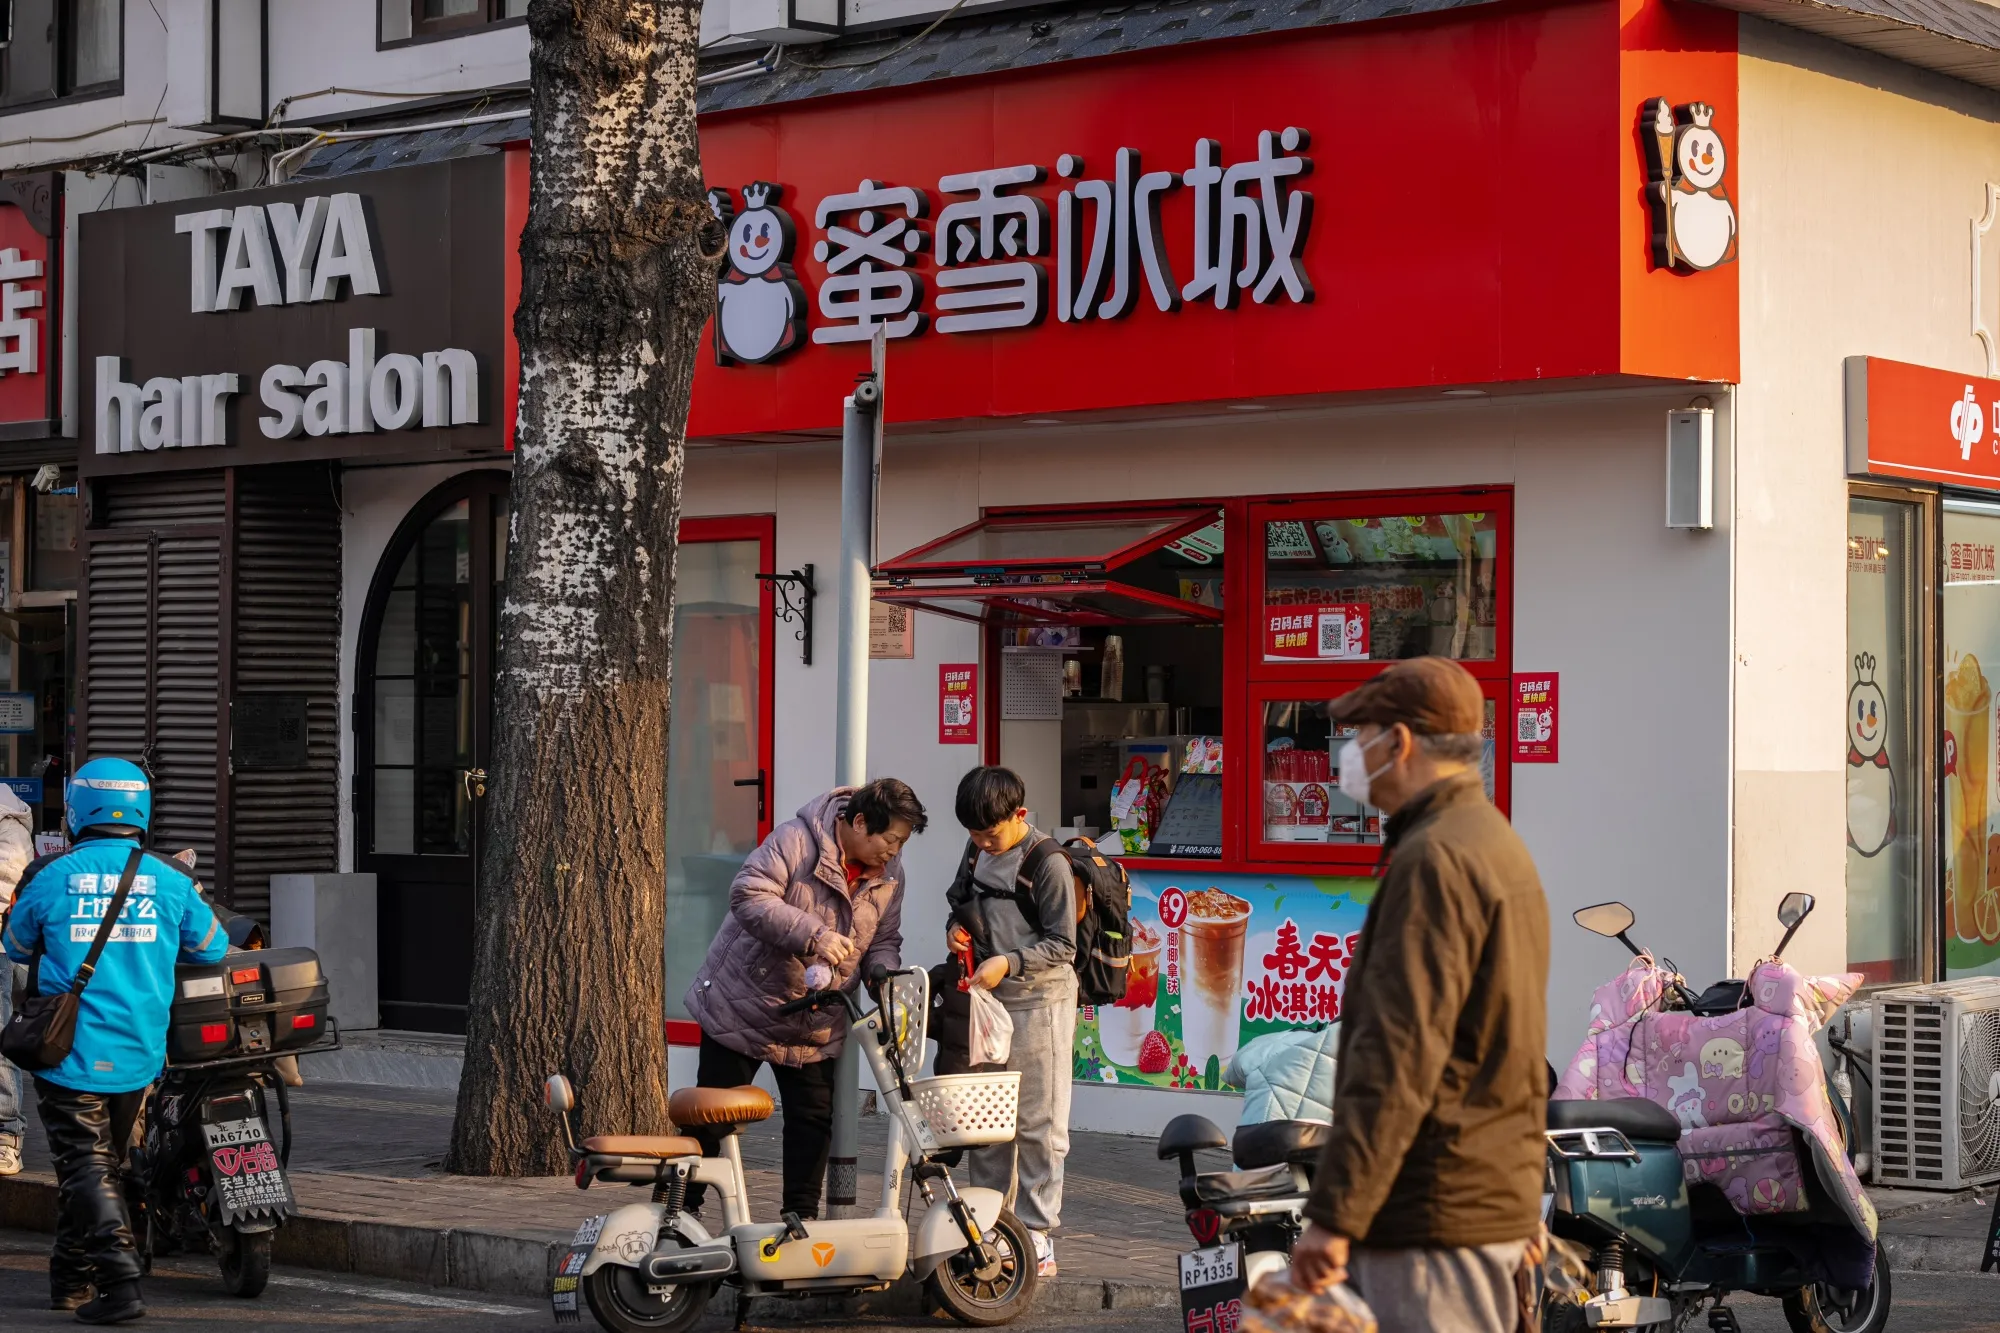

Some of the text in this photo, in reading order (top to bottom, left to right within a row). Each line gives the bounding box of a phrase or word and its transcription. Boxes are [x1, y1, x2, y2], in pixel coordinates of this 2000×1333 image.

[812, 126, 1312, 345] 蜜雪冰城
[174, 192, 381, 313] TAYA
[96, 328, 479, 455] hair salon
[1950, 542, 1995, 571] 蜜雪冰城
[1269, 614, 1314, 631] 扫码点餐
[1274, 632, 1309, 648] 更快哦
[945, 671, 971, 681] 扫码点餐
[1519, 681, 1551, 692] 扫码点餐
[78, 874, 148, 895] 点外卖
[70, 898, 157, 919] 上饿了么
[1169, 892, 1184, 923] 9
[1166, 931, 1179, 995] 椰椰拿铁
[1244, 974, 1340, 1022] 冰淇淋
[209, 1128, 262, 1145] NA6710
[220, 1170, 283, 1191] 天竺总代理
[1194, 1250, 1226, 1267] 北京
[1184, 1262, 1234, 1286] RP1335
